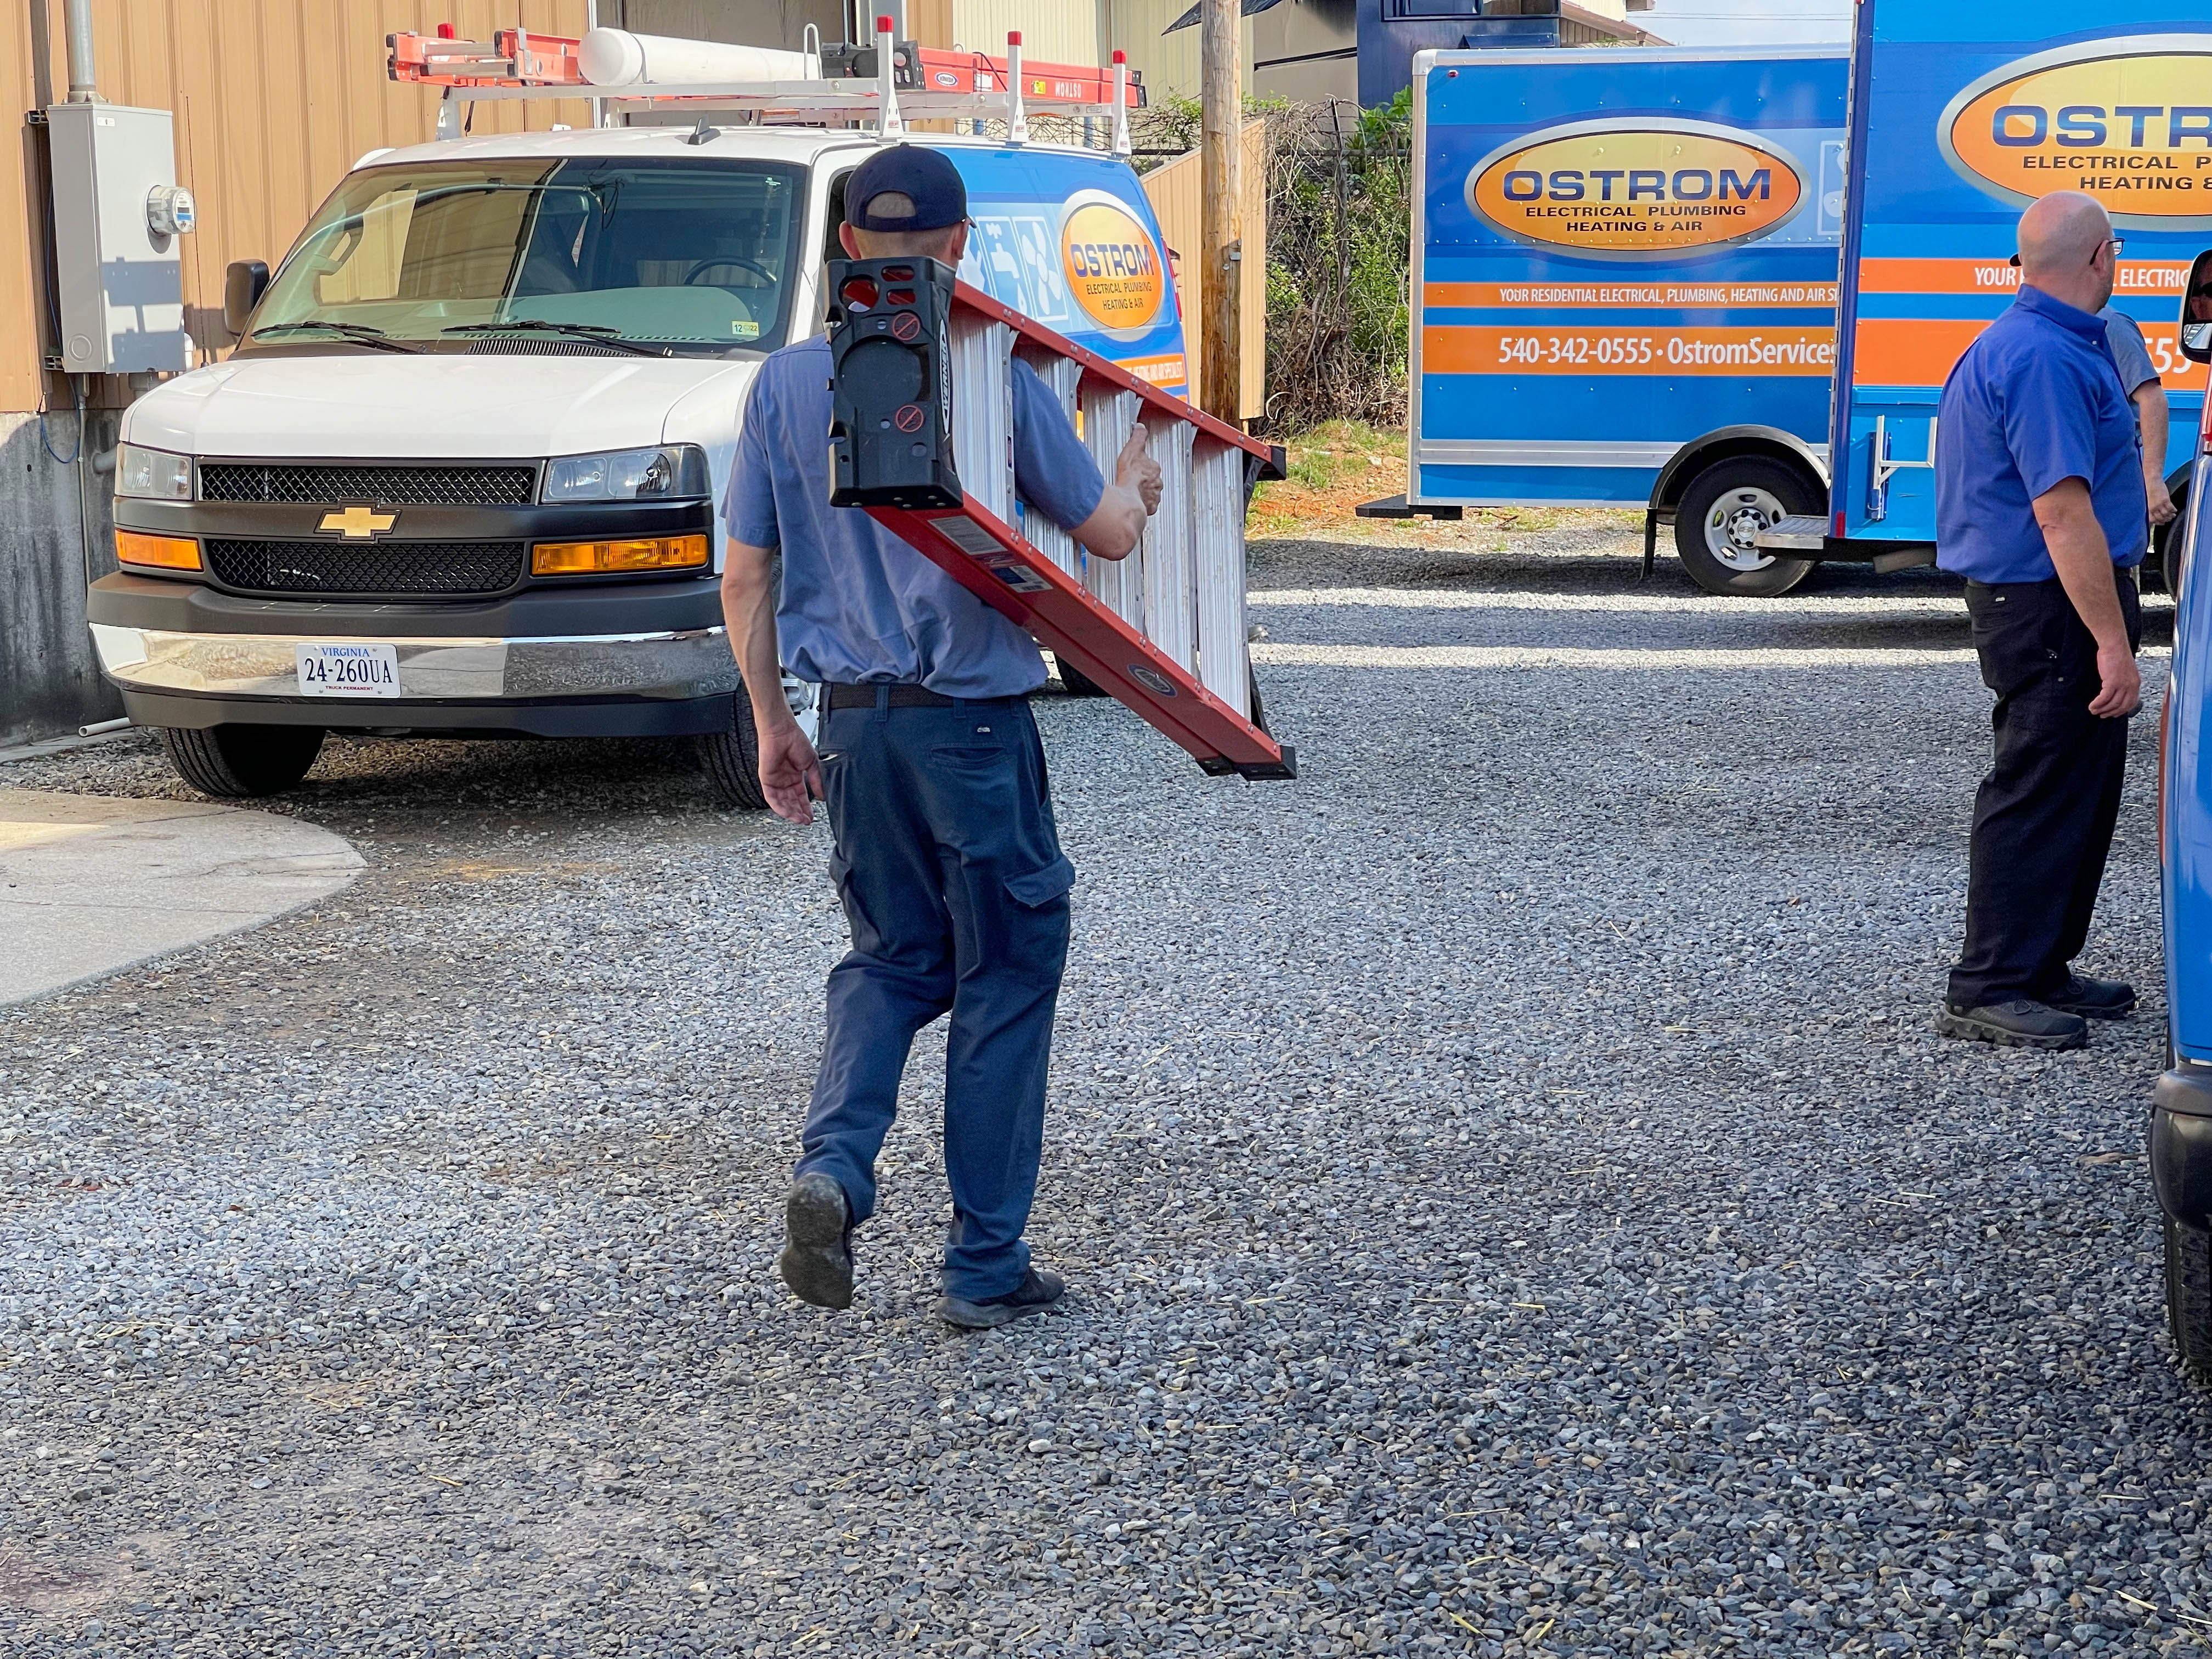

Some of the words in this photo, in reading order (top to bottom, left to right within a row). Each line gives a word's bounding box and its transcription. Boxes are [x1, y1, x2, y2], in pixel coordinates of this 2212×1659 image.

[1055, 82, 1081, 98] OSTROM
[2023, 156, 2178, 168] ELECTRICAL
[1504, 169, 1771, 201] OSTROM
[2080, 177, 2192, 189] HEATING
[1526, 206, 1636, 217] ELECTRICAL
[1648, 206, 1746, 216] PLUMBING
[1566, 222, 1646, 232] HEATING
[1654, 222, 1664, 231] &
[1671, 221, 1703, 231] AIR
[1070, 244, 1154, 277] OSTROM
[1975, 267, 2017, 285] YOUR
[1086, 283, 1122, 295] ELECTRICAL
[1124, 281, 1152, 293] PLUMBING
[1499, 289, 1528, 302] YOUR
[1531, 289, 1598, 302] RESIDENTIAL
[1600, 289, 1664, 304] ELECTRICAL,
[1667, 288, 1728, 304] PLUMBING,
[1731, 288, 1778, 302] HEATING
[1780, 288, 1804, 302] AND
[1807, 287, 1825, 301] AIR
[1103, 300, 1128, 310] HEATING
[1135, 298, 1144, 308] AIR
[1499, 337, 1652, 363] 540-342-0555
[321, 647, 370, 657] VIRGINIA
[304, 658, 393, 683] 24-260UA
